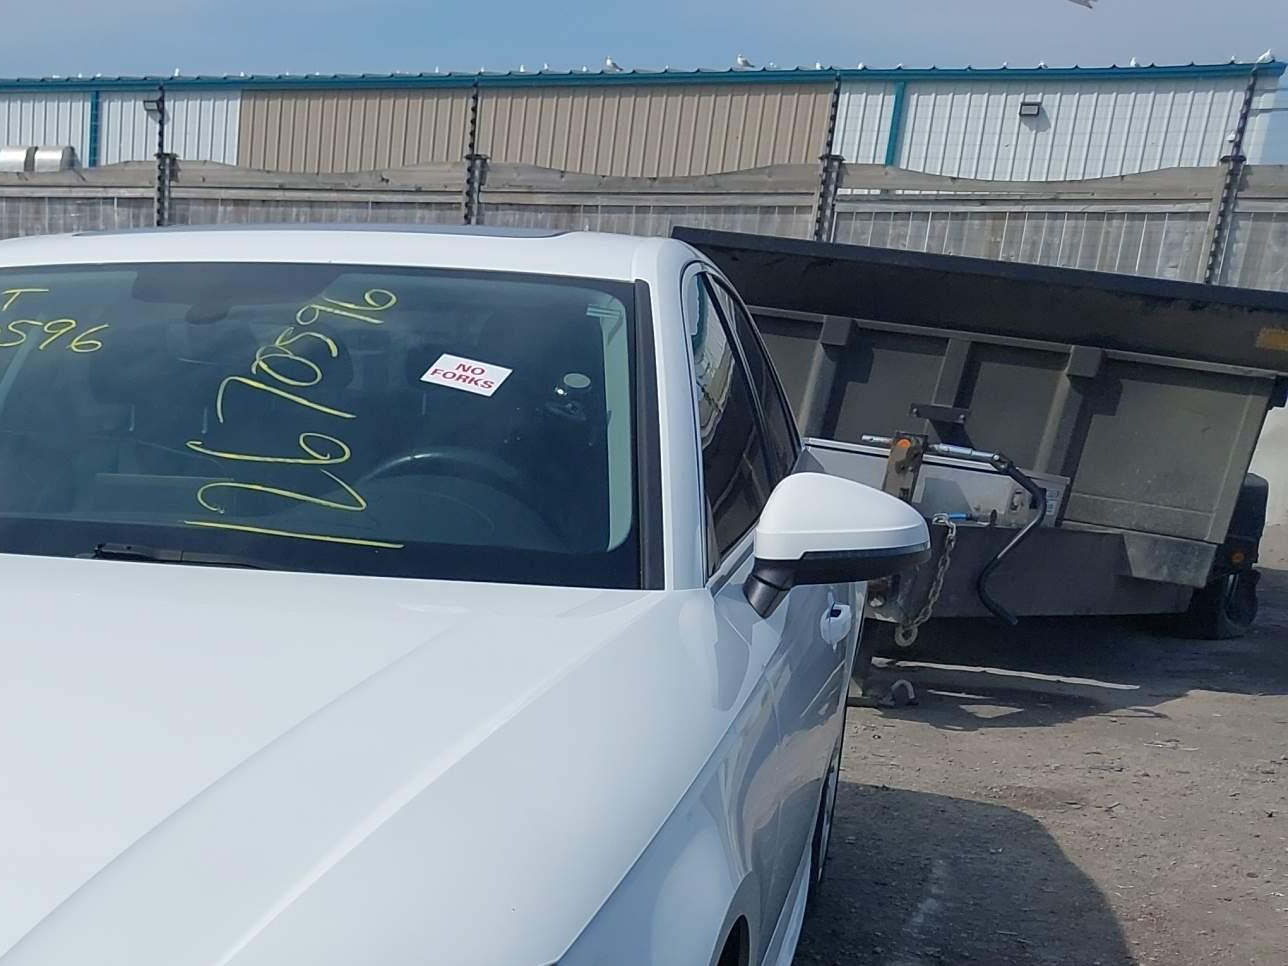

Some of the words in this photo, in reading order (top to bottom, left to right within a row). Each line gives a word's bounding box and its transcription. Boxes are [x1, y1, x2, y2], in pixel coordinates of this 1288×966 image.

[430, 368, 495, 389] FORKS
[455, 363, 486, 376] NO
[184, 288, 404, 548] 12670596
